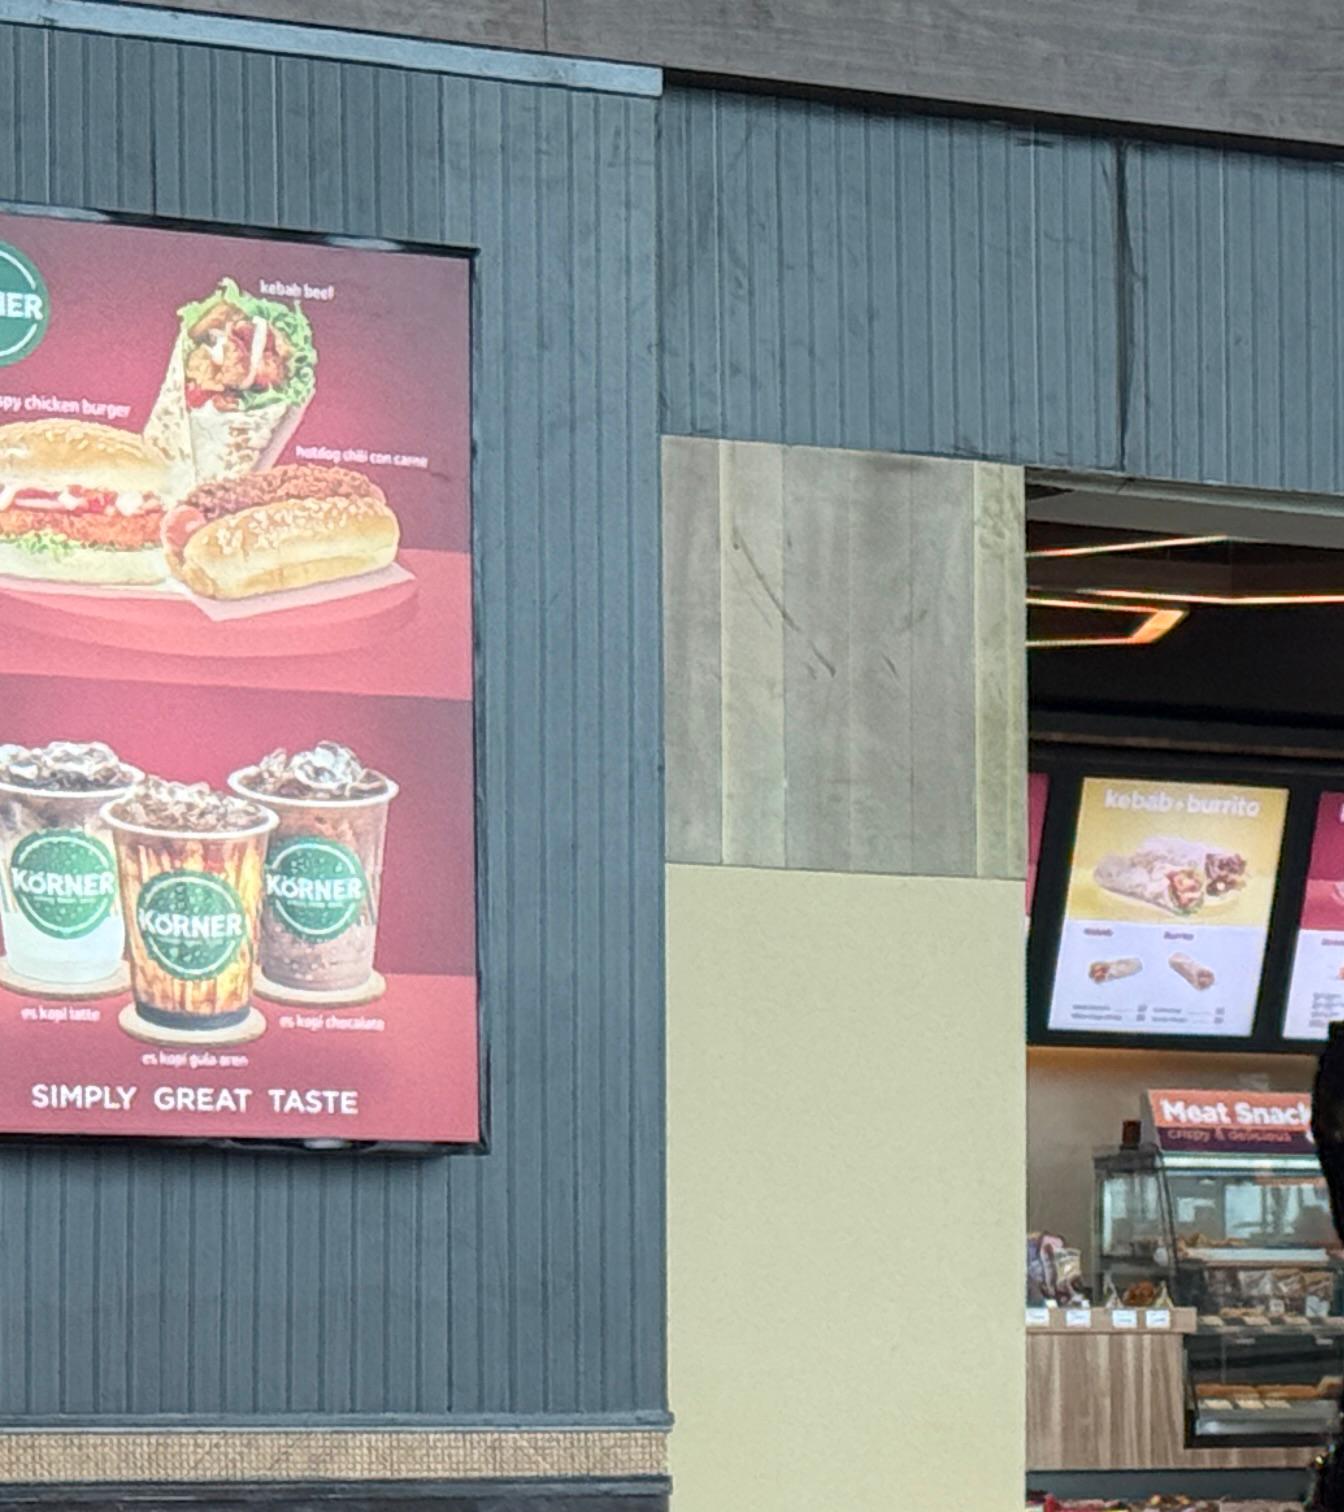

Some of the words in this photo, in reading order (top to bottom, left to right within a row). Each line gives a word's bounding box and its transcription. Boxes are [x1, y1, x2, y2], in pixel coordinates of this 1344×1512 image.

[0, 292, 43, 320] ER
[24, 395, 79, 412] chicken
[82, 398, 131, 419] burger
[1104, 789, 1172, 812] kebab
[1187, 793, 1260, 818] burrito
[11, 867, 114, 896] KÖRNER
[265, 874, 361, 900] KÖRNER
[139, 907, 243, 938] KÖRNER
[31, 1084, 137, 1110] SIMPLY
[153, 1086, 252, 1113] GREAT
[268, 1088, 359, 1115] TASTE
[1160, 1098, 1231, 1125] Meat
